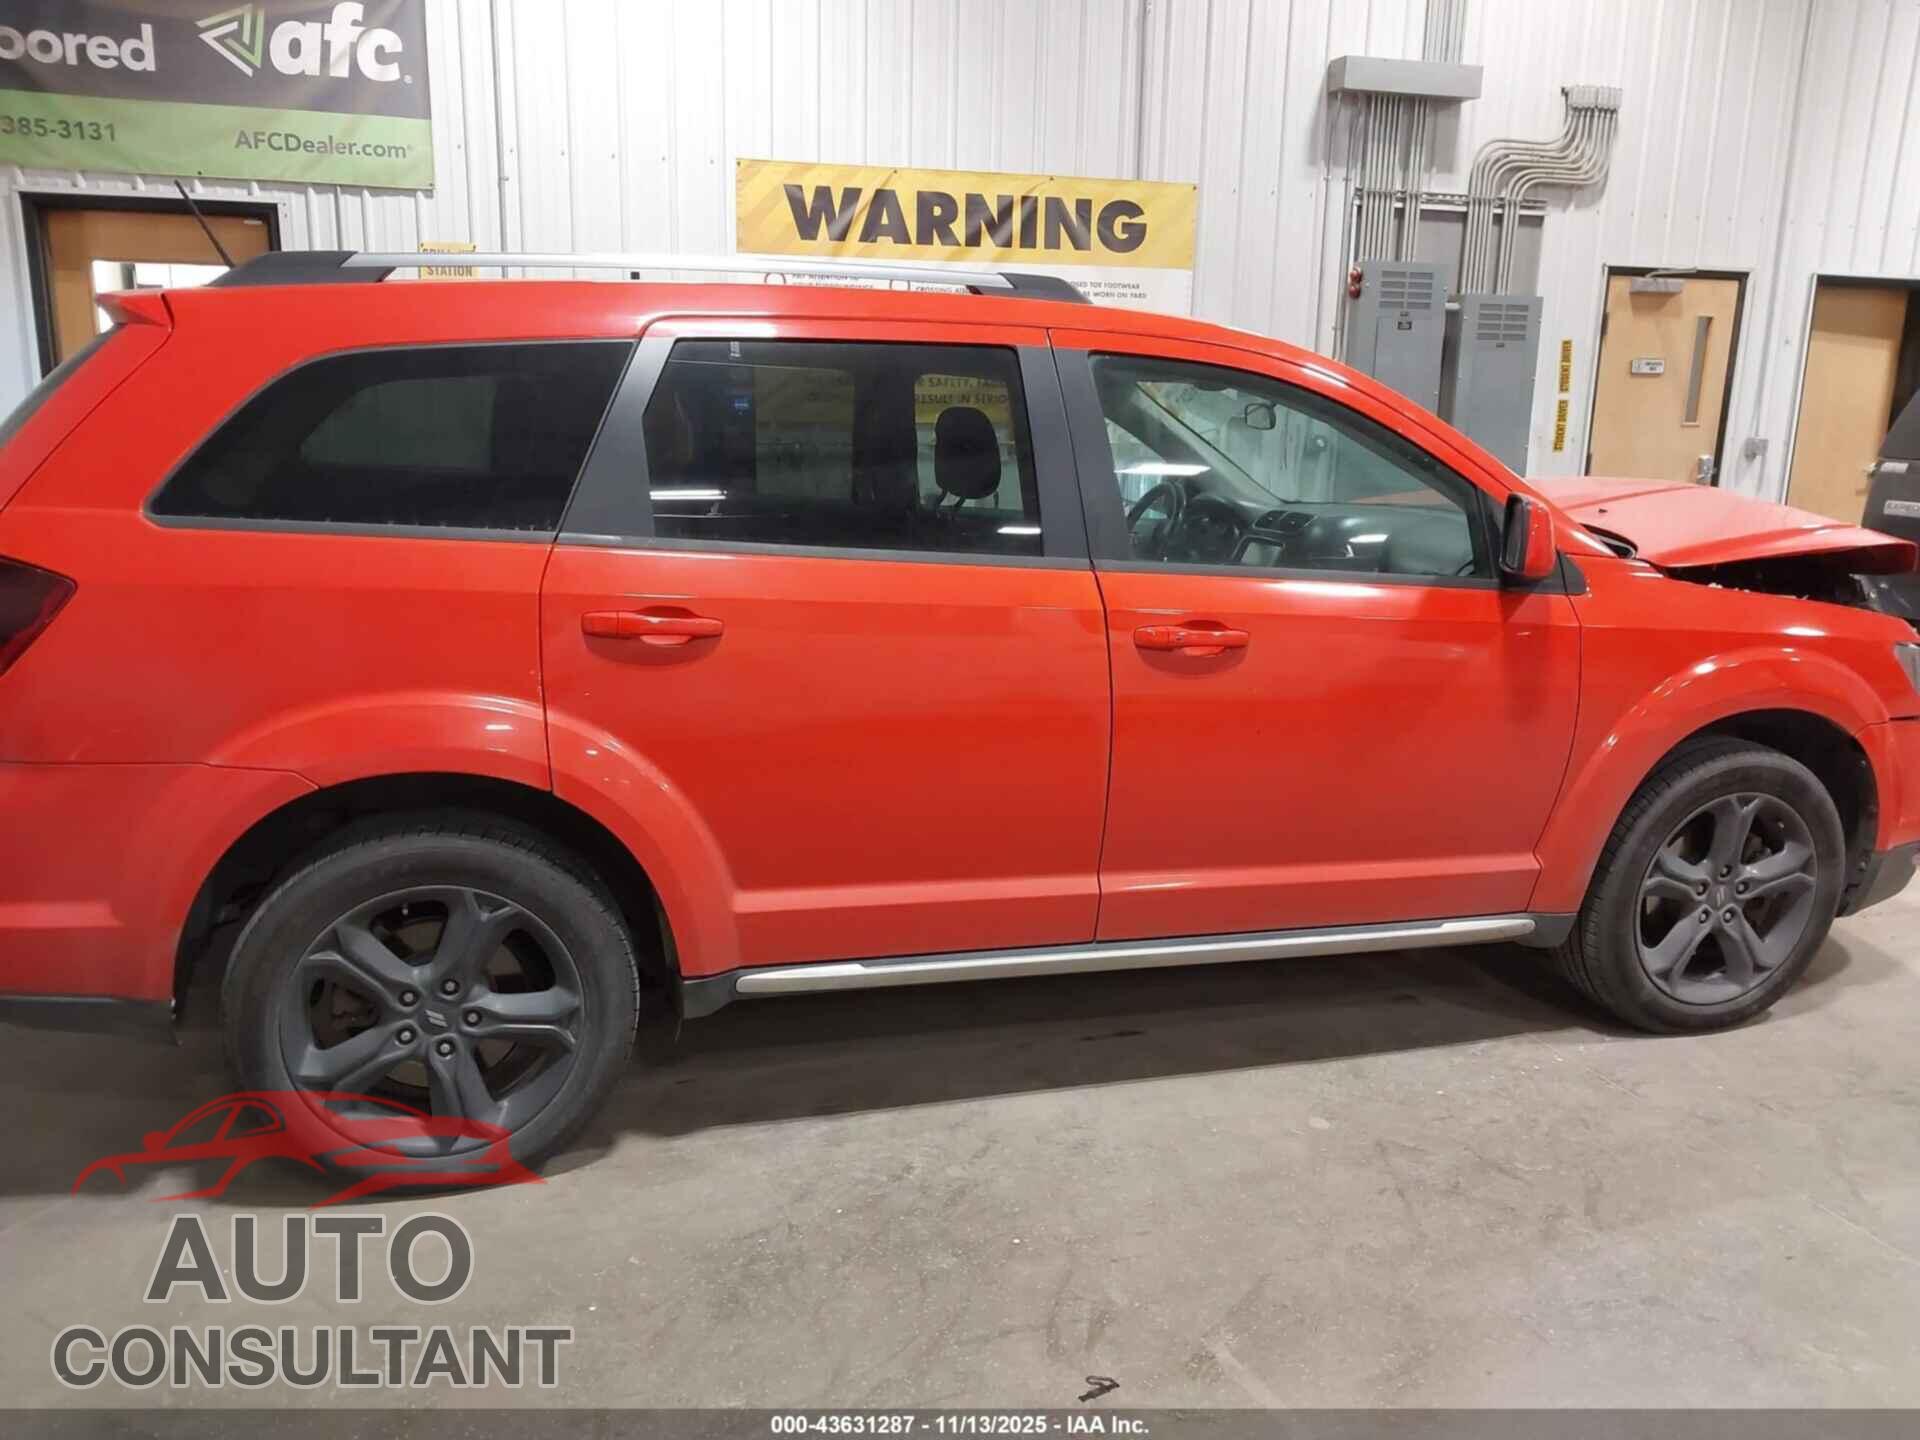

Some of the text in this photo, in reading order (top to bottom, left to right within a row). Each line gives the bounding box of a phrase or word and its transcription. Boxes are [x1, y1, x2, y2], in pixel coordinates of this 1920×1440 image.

[1, 115, 116, 141] 385-3131
[235, 130, 408, 158] AFCDealer.com
[783, 183, 1148, 254] WARNING
[1104, 281, 1140, 290] FOOTWEAR
